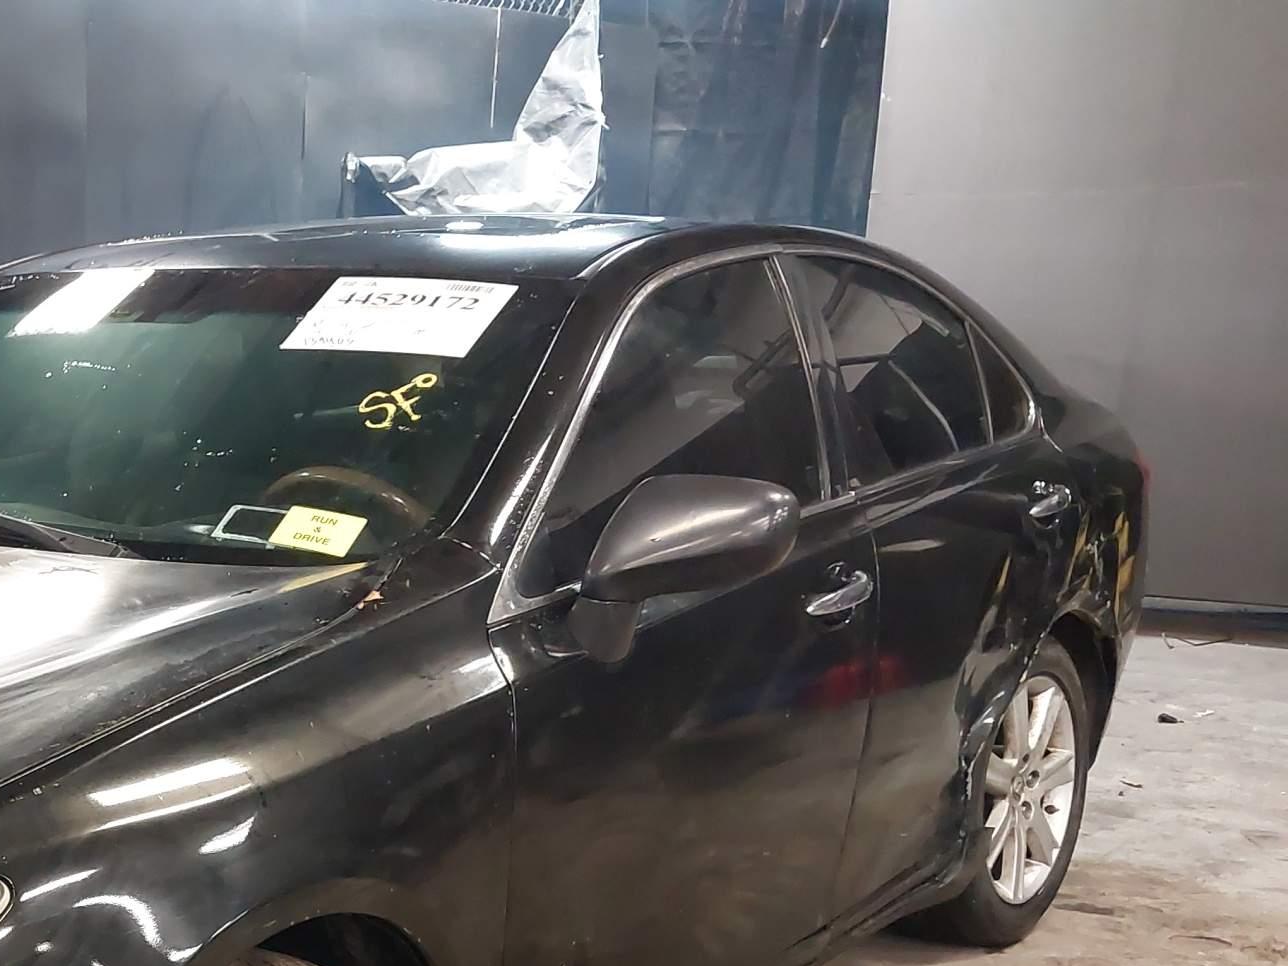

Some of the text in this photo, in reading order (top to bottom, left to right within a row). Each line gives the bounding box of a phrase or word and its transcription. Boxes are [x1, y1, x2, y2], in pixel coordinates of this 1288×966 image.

[337, 291, 481, 311] 44529172
[311, 514, 339, 526] RUN
[313, 526, 322, 534] &
[292, 532, 331, 546] DRIVE
